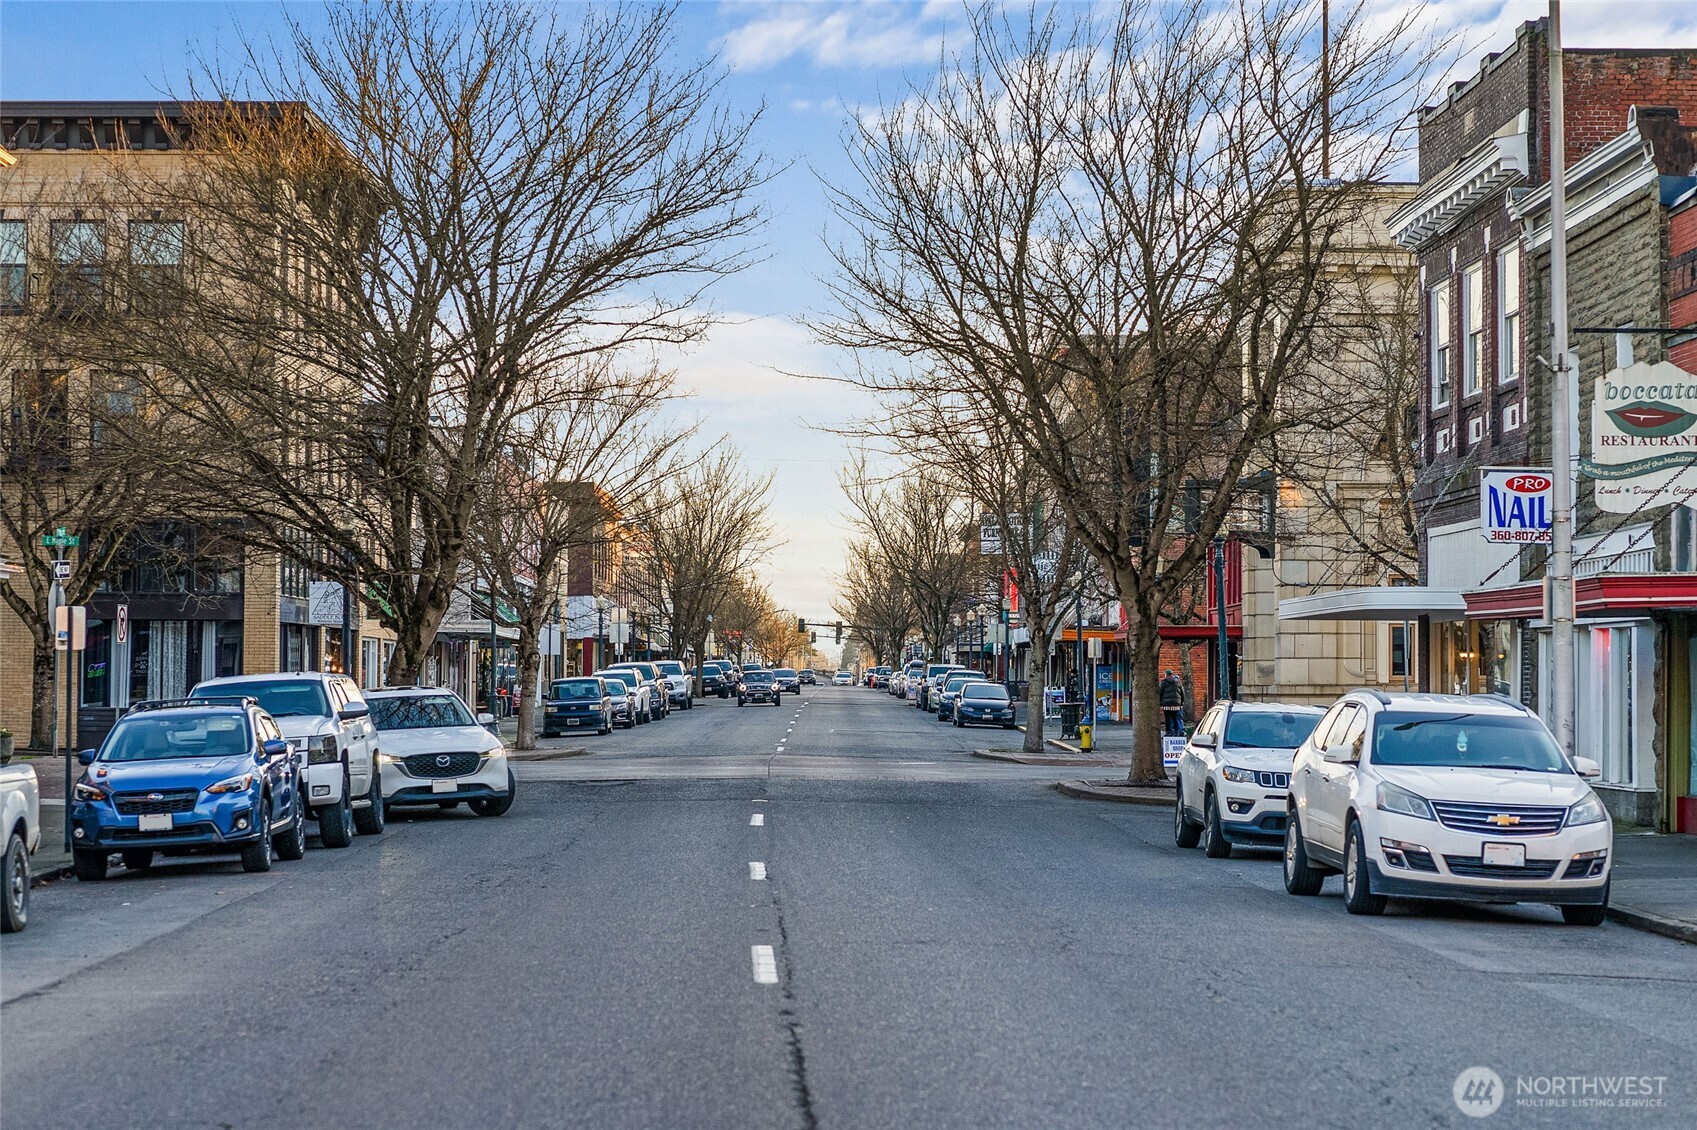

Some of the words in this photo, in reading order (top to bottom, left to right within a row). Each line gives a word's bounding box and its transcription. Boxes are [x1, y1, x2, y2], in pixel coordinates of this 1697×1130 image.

[1604, 382, 1697, 400] boccata
[1601, 435, 1697, 446] RESTAURANT
[1610, 465, 1642, 476] mouthful
[1643, 462, 1651, 471] of
[1652, 459, 1664, 468] the
[1513, 478, 1546, 490] PRO
[1598, 486, 1622, 495] Lunch
[46, 536, 51, 544] E
[69, 536, 75, 545] St
[1099, 672, 1113, 680] ICE
